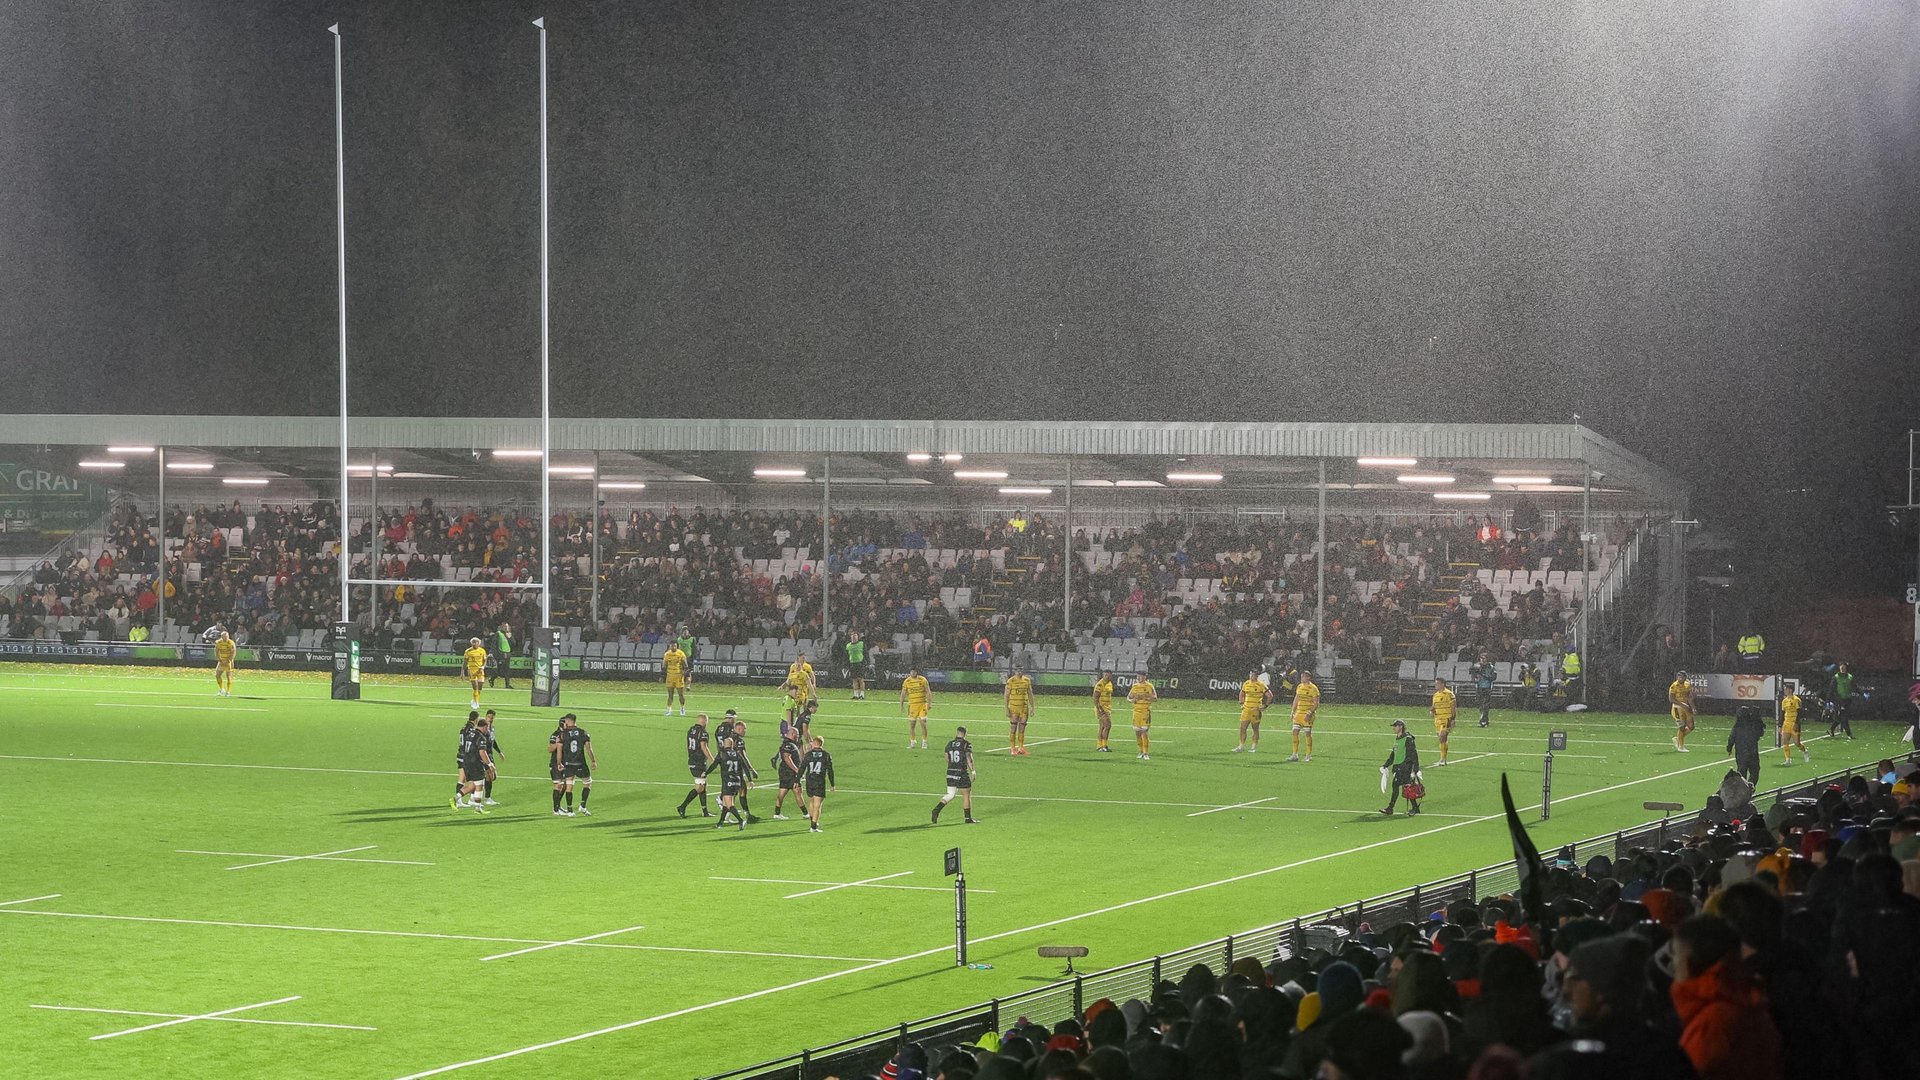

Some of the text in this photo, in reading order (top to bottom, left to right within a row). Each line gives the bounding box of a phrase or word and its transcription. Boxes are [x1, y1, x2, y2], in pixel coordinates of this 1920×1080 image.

[1906, 588, 1917, 604] 8
[274, 652, 296, 661] macron
[391, 656, 413, 664] macron
[441, 657, 464, 665] GILB
[590, 662, 603, 670] JOIN
[604, 662, 617, 671] URC
[617, 662, 636, 671] FRONT
[637, 663, 651, 671] ROW
[702, 665, 721, 673] FRONT
[722, 666, 736, 674] ROW
[1690, 679, 1708, 687] FFEE
[1737, 685, 1757, 698] SO
[570, 740, 578, 753] 6
[949, 750, 960, 763] 16
[726, 760, 738, 773] 21
[809, 761, 822, 774] 14
